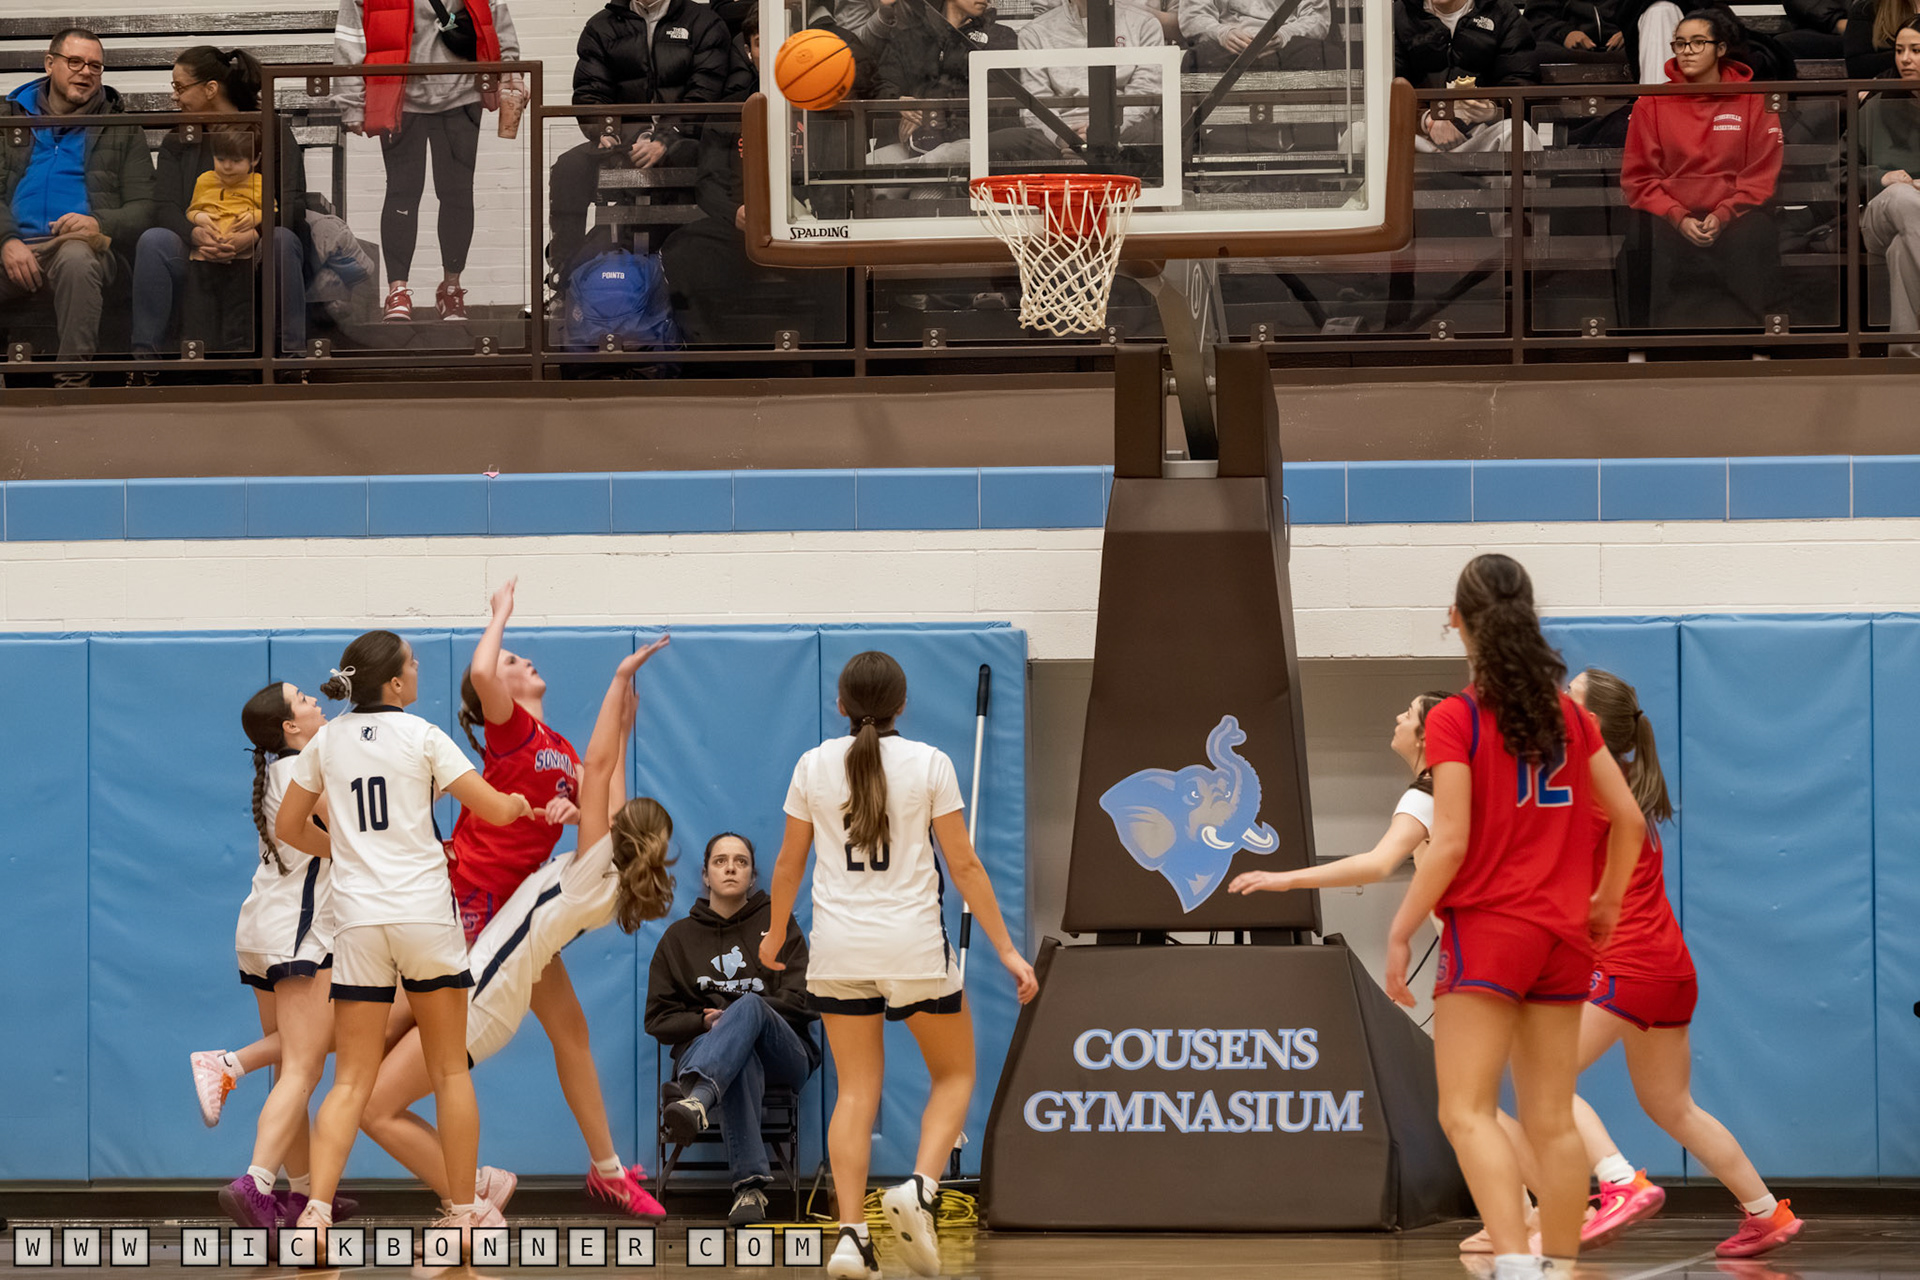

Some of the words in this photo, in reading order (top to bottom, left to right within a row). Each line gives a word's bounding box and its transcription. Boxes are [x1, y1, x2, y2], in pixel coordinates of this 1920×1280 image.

[789, 225, 849, 240] SPALDING
[350, 775, 390, 832] 10
[1073, 1028, 1320, 1071] COUSENS
[1023, 1090, 1364, 1133] GYMNASIUM
